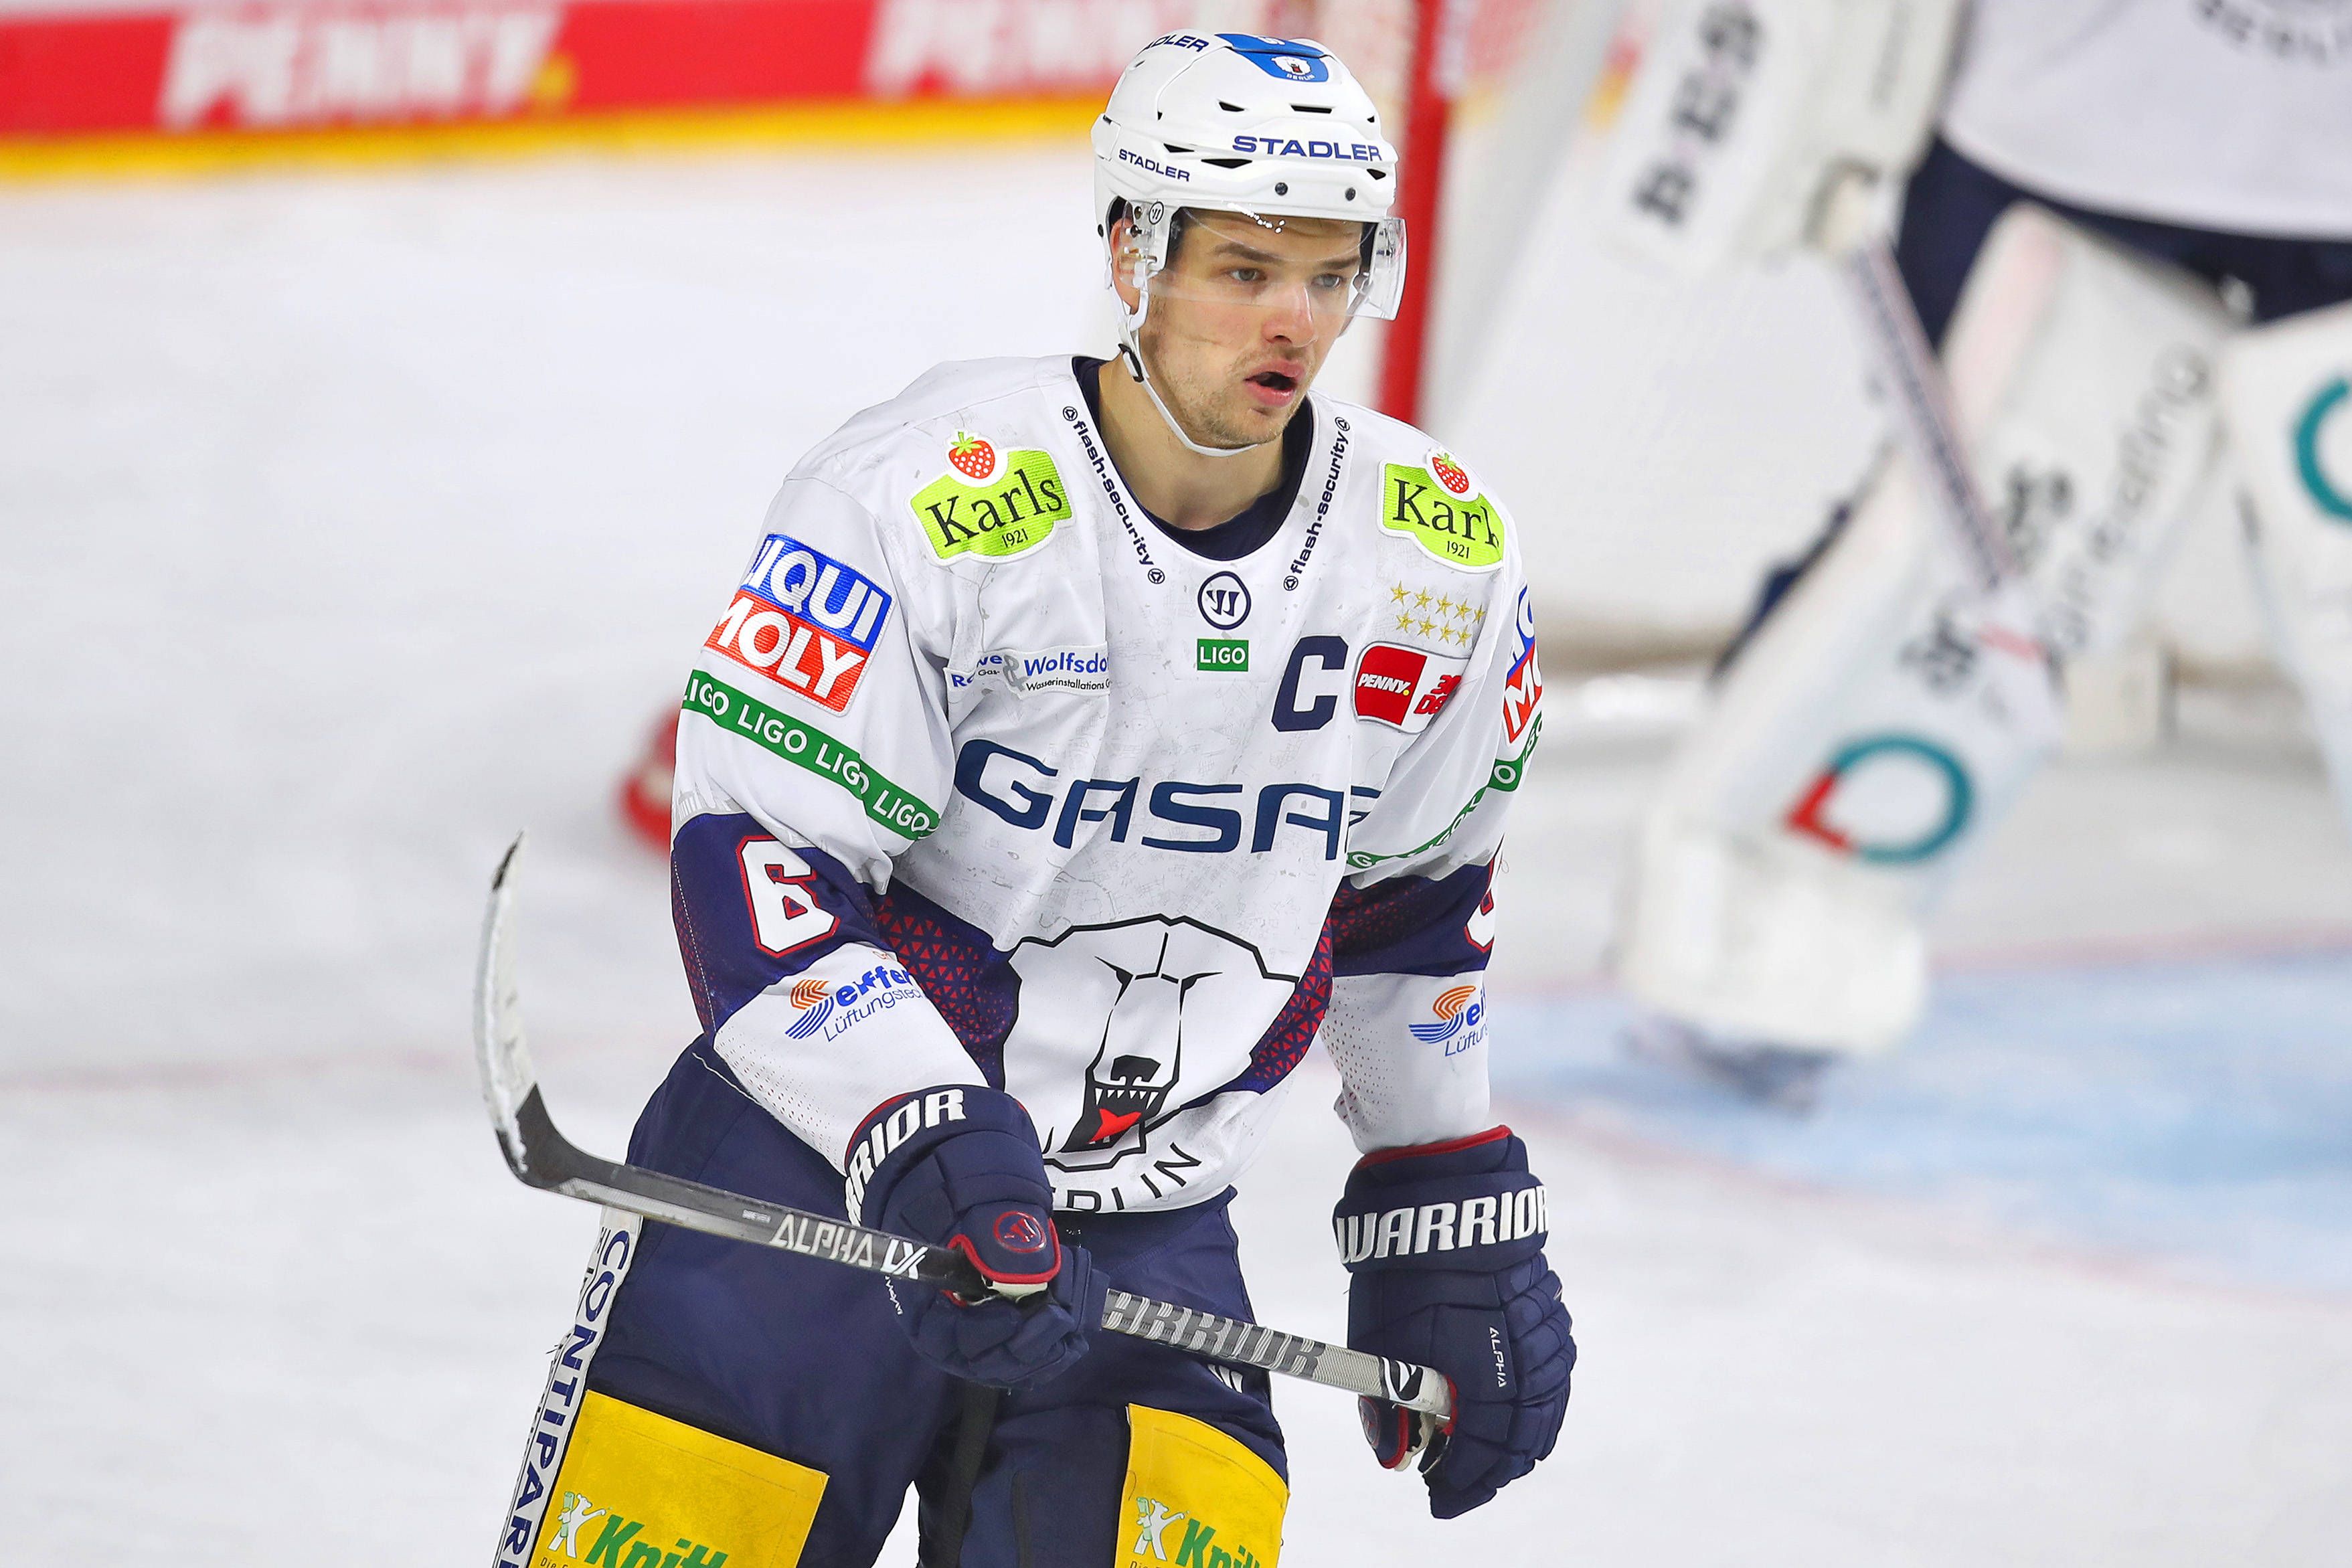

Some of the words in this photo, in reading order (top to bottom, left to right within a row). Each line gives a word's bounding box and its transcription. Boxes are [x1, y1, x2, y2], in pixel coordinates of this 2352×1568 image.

[1118, 149, 1190, 182] STADLER
[1232, 135, 1383, 162] STADLER
[926, 469, 1062, 547] Karls
[1073, 420, 1155, 565] flash-security
[1290, 431, 1349, 574] flash-security
[1002, 529, 1028, 547] 1921
[1446, 541, 1469, 559] 1921
[1024, 652, 1108, 676] Wolfsdo
[1199, 646, 1246, 663] LIGO
[1271, 636, 1349, 731] C
[738, 704, 807, 754] LIGO
[815, 742, 869, 794] LIGO
[872, 790, 931, 832] LIGO
[738, 837, 839, 957] 6
[1445, 1024, 1487, 1056] Lüftun
[769, 1213, 873, 1268] ALPHA
[1337, 1185, 1548, 1264] WARRIOR
[1103, 1288, 1327, 1377] ARRIOR
[1489, 1326, 1507, 1388] ALPHA
[499, 1230, 630, 1568] CONTIPAR
